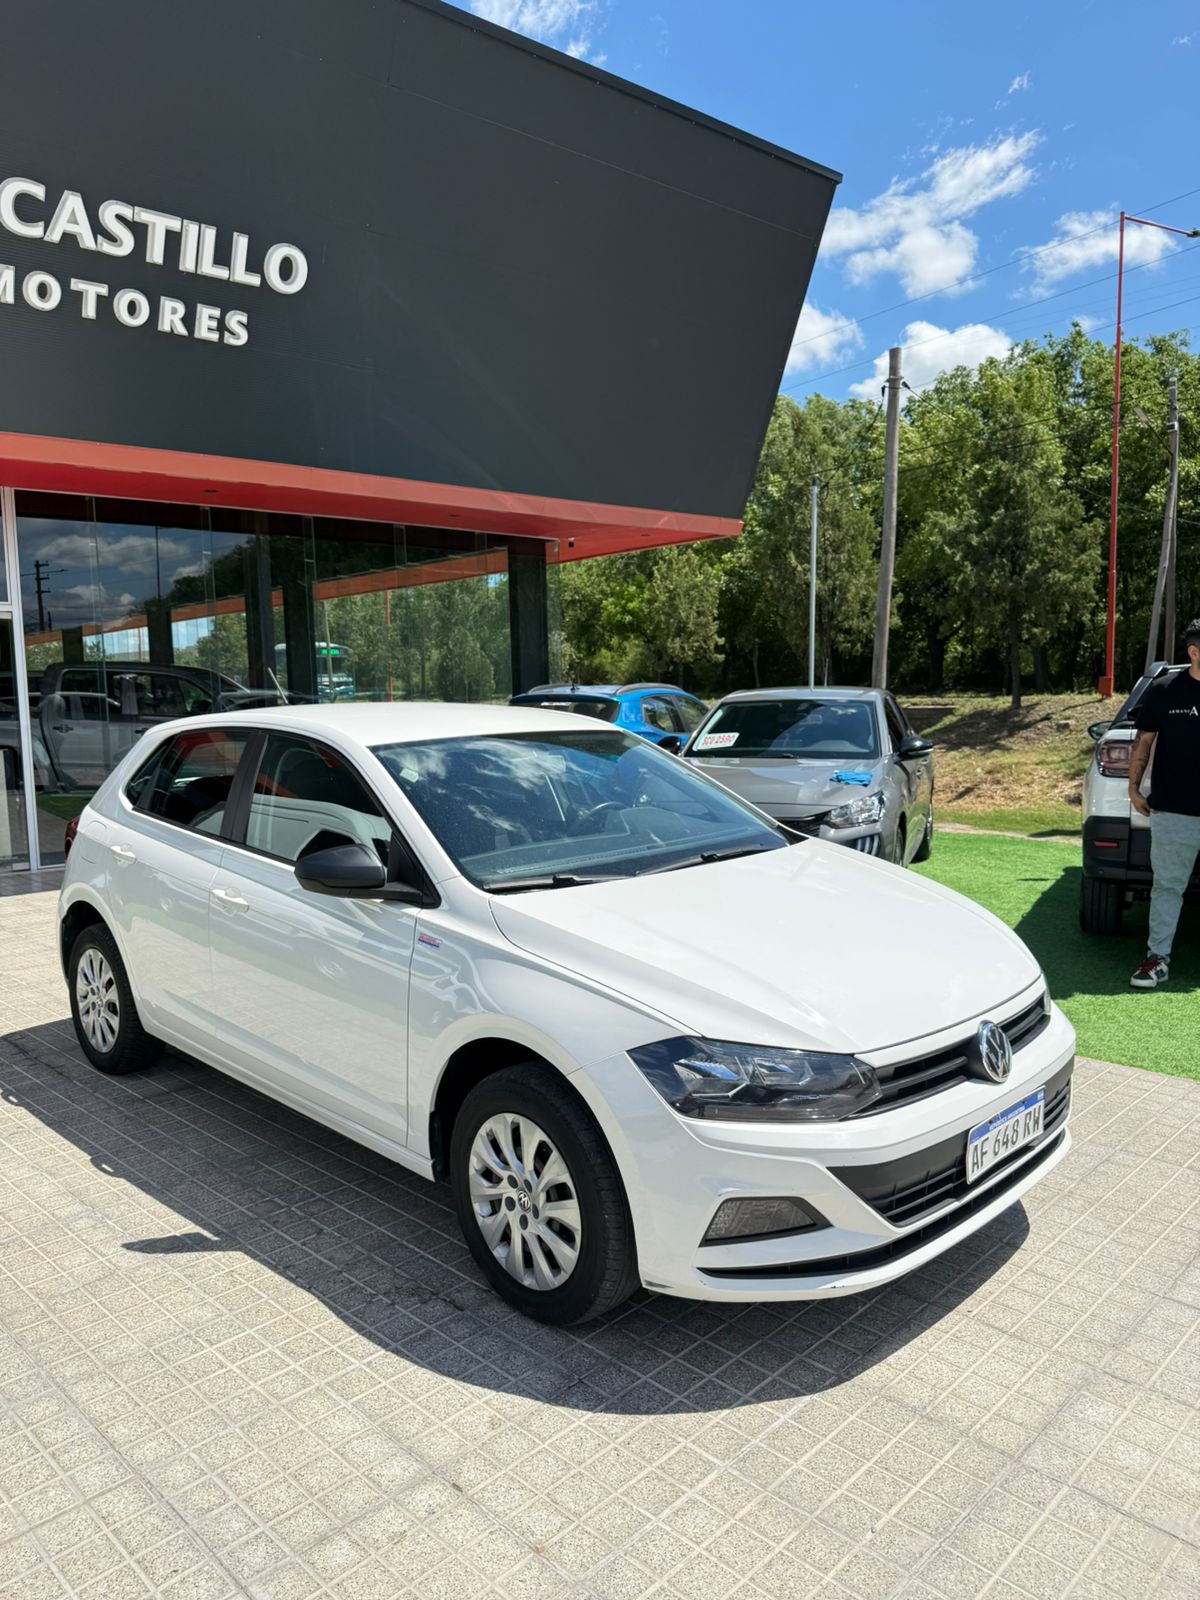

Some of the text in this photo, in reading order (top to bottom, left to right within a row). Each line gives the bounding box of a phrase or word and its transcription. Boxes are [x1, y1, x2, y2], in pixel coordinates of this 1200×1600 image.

[0, 177, 308, 295] CASTILLO
[972, 1136, 989, 1174] AF
[993, 1119, 1019, 1156] 648
